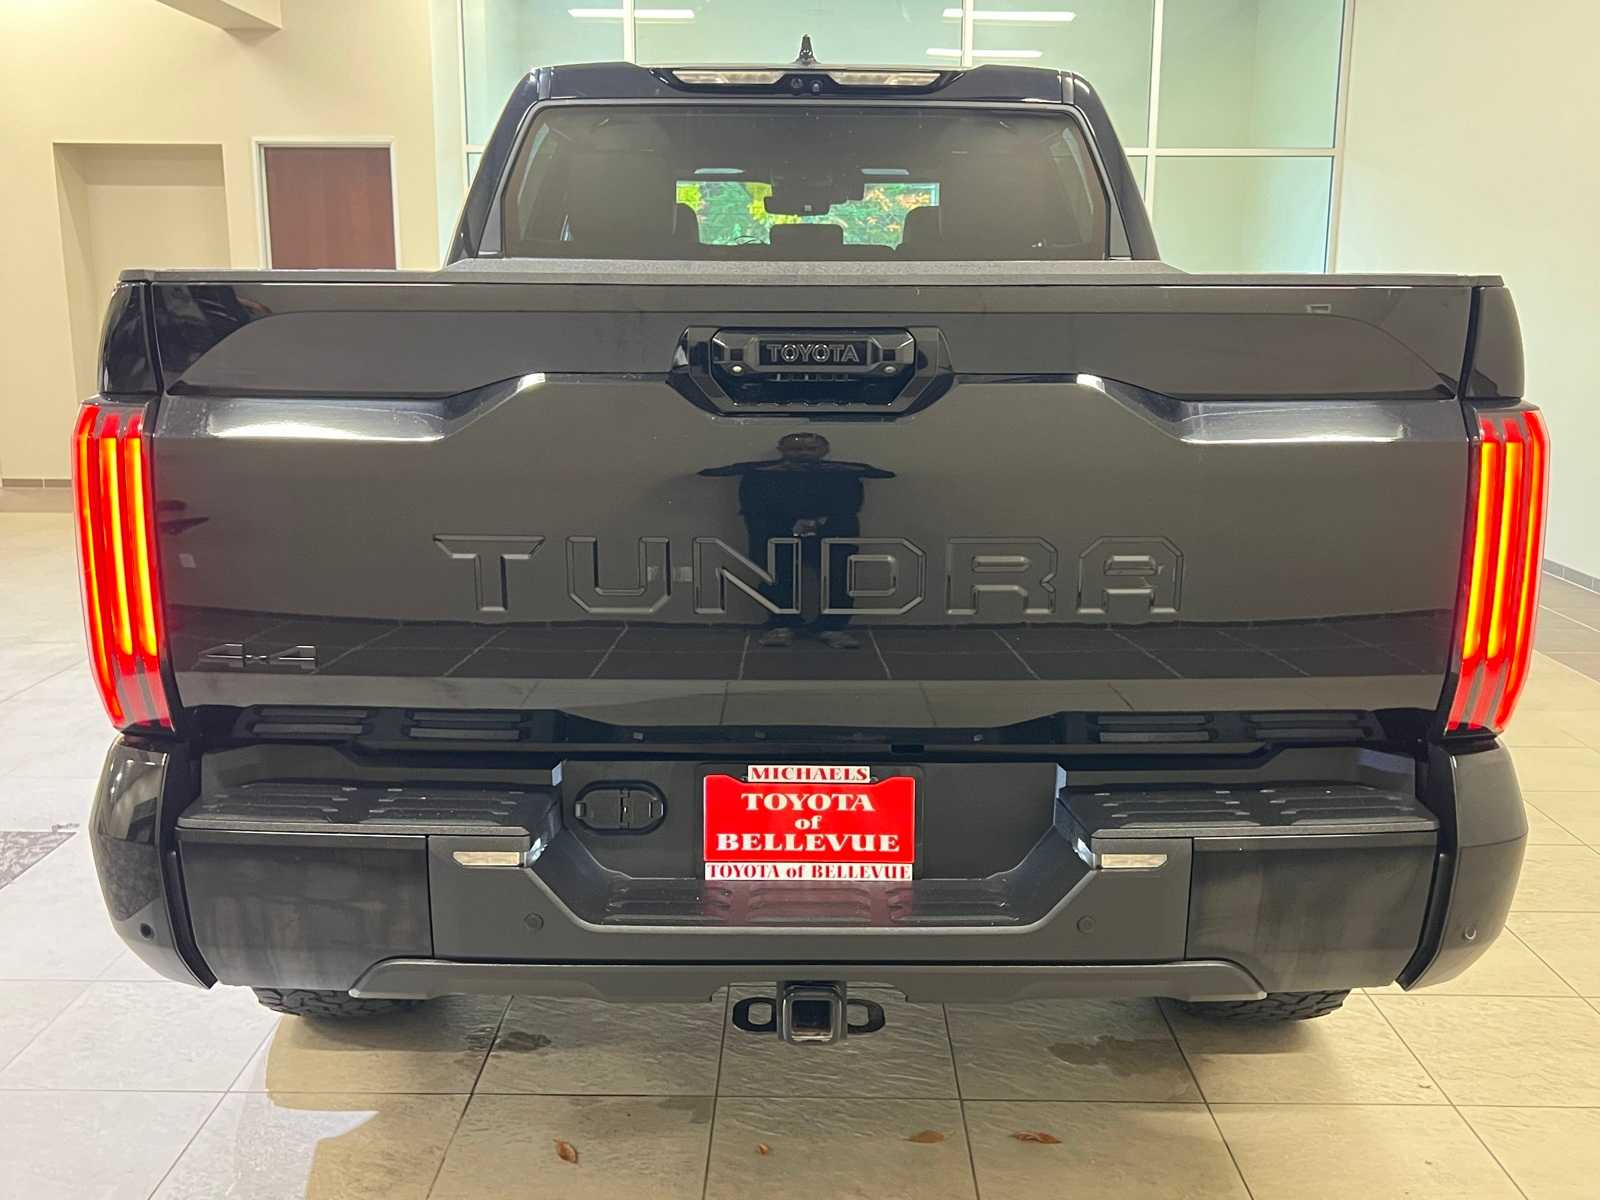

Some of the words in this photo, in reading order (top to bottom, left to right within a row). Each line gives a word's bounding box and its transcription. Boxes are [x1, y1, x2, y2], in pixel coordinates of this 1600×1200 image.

[766, 343, 861, 363] TOYOTA
[433, 534, 1185, 616] TUNDRA
[751, 767, 867, 780] MICHAELS
[741, 793, 875, 811] TOYOTA
[794, 815, 822, 829] of
[716, 833, 899, 851] BELLEVUE
[707, 864, 780, 878] TOYOTA
[786, 865, 804, 878] of
[811, 864, 911, 879] BELLEVUE
